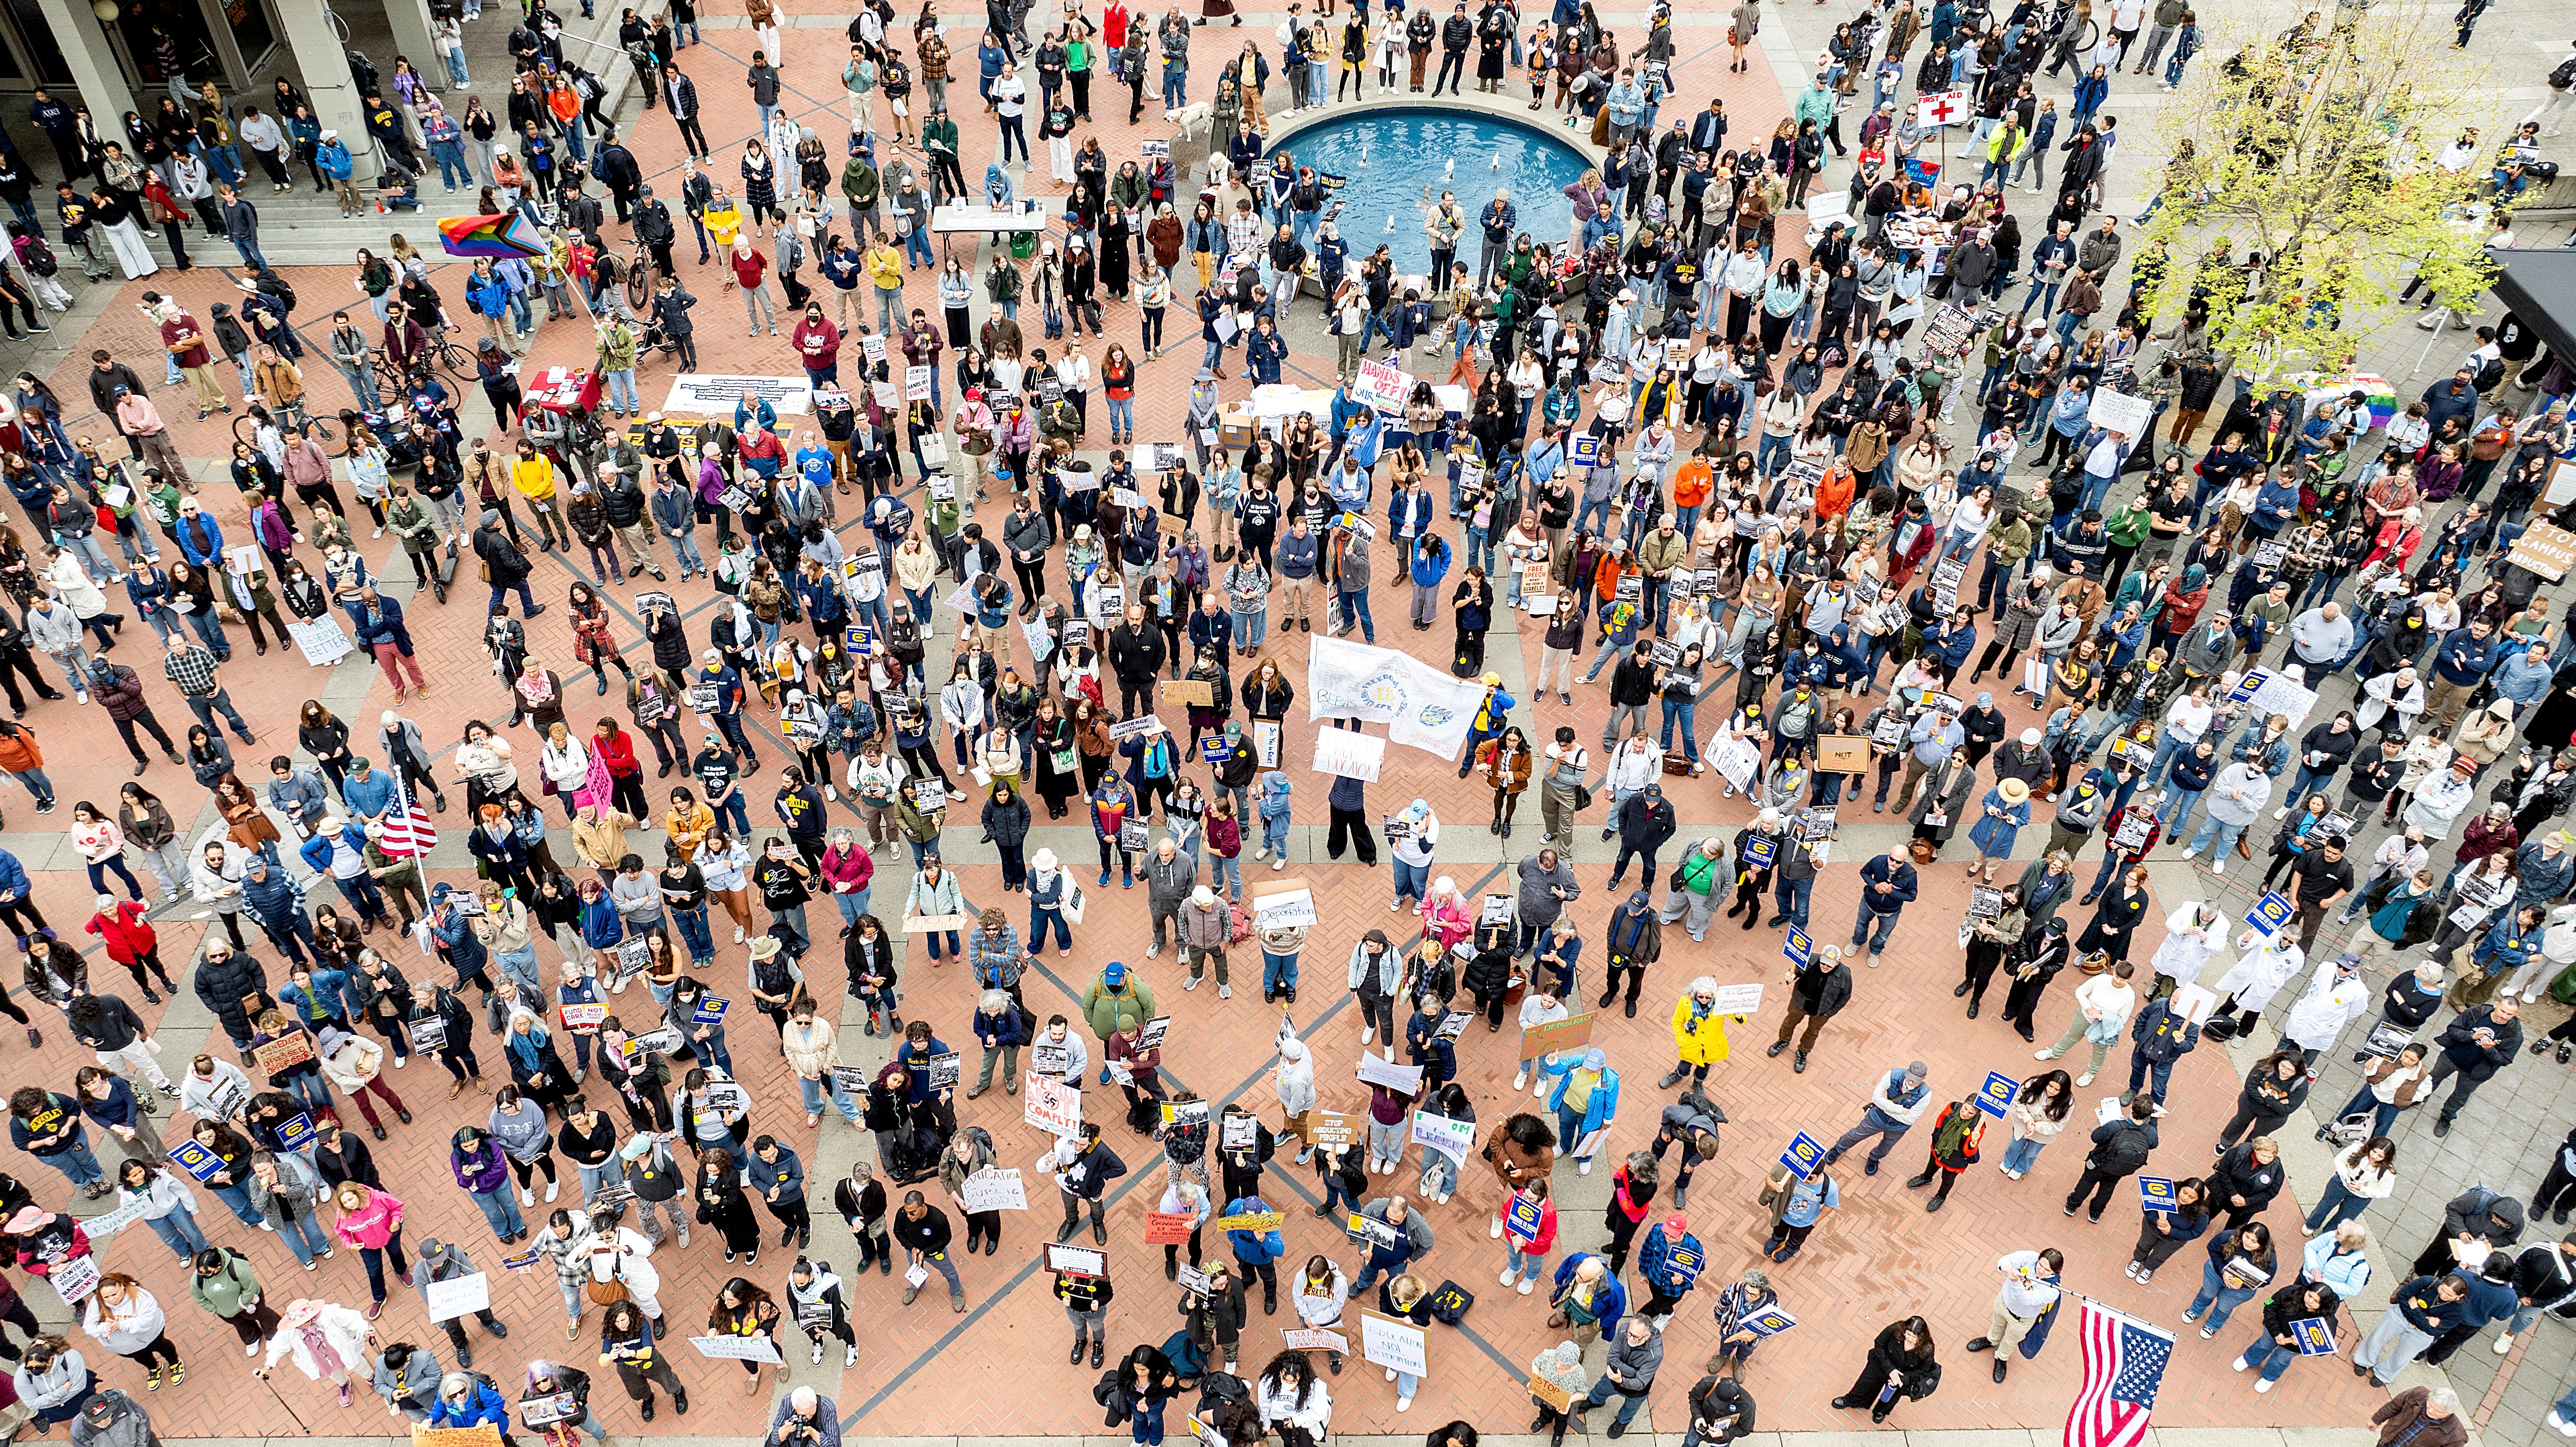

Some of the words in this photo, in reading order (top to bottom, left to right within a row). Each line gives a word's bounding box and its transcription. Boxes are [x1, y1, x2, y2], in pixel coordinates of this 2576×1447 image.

[1918, 95, 1939, 104] FIRST
[1362, 360, 1401, 384] HANDS
[907, 382, 921, 390] HANDS
[908, 386, 929, 397] STUDENTS
[1356, 388, 1373, 400] OUR
[1375, 381, 1406, 399] OFF!
[877, 392, 896, 401] PALESTINE
[1116, 489, 1133, 498] HELL
[2532, 522, 2576, 552] STO
[2520, 536, 2574, 565] CAMPUS
[2508, 550, 2564, 580] ABDUCTIONS
[291, 615, 335, 634] STUDENTS
[299, 627, 341, 645] DESERVE
[306, 634, 348, 657] BETTER
[1172, 682, 1209, 692] ABOLIH
[1117, 718, 1149, 729] COURAGE
[1823, 739, 1864, 753] DEFEND
[1827, 759, 1860, 770] DEFUND
[1260, 908, 1315, 924] Deportation
[1544, 1015, 1592, 1031] DEMOCRACY
[260, 1046, 277, 1055] WHEN
[263, 1047, 305, 1068] OPPRESSED
[1028, 1072, 1047, 1090] WE
[1048, 1080, 1075, 1101] WILL
[31, 1108, 63, 1132] BERKELEY
[1027, 1102, 1077, 1129] COMPLY!
[1312, 1126, 1352, 1134] ABDUCTING
[1319, 1134, 1347, 1142] PEOPLE
[1416, 1127, 1466, 1157] LEARN
[964, 1171, 1021, 1191] EDUCATION
[966, 1188, 1020, 1203] PUBLIC
[972, 1196, 1021, 1209] GOOD!
[84, 1210, 120, 1227] FUND
[124, 1197, 144, 1212] OUR
[93, 1205, 146, 1233] FUTURE!
[1148, 1213, 1189, 1222] PROTESTING
[58, 1261, 86, 1281] JEWISH
[62, 1273, 79, 1286] VOICES
[63, 1280, 83, 1297] HANDS
[67, 1276, 99, 1301] STUDENTS
[695, 1337, 766, 1347] PROTECT
[1367, 1324, 1423, 1348] EDUCATION
[1381, 1340, 1402, 1353] NOT
[704, 1349, 775, 1361] STUDENTS
[1367, 1347, 1423, 1368] DEPORTATION
[1536, 1376, 1561, 1394] STOP
